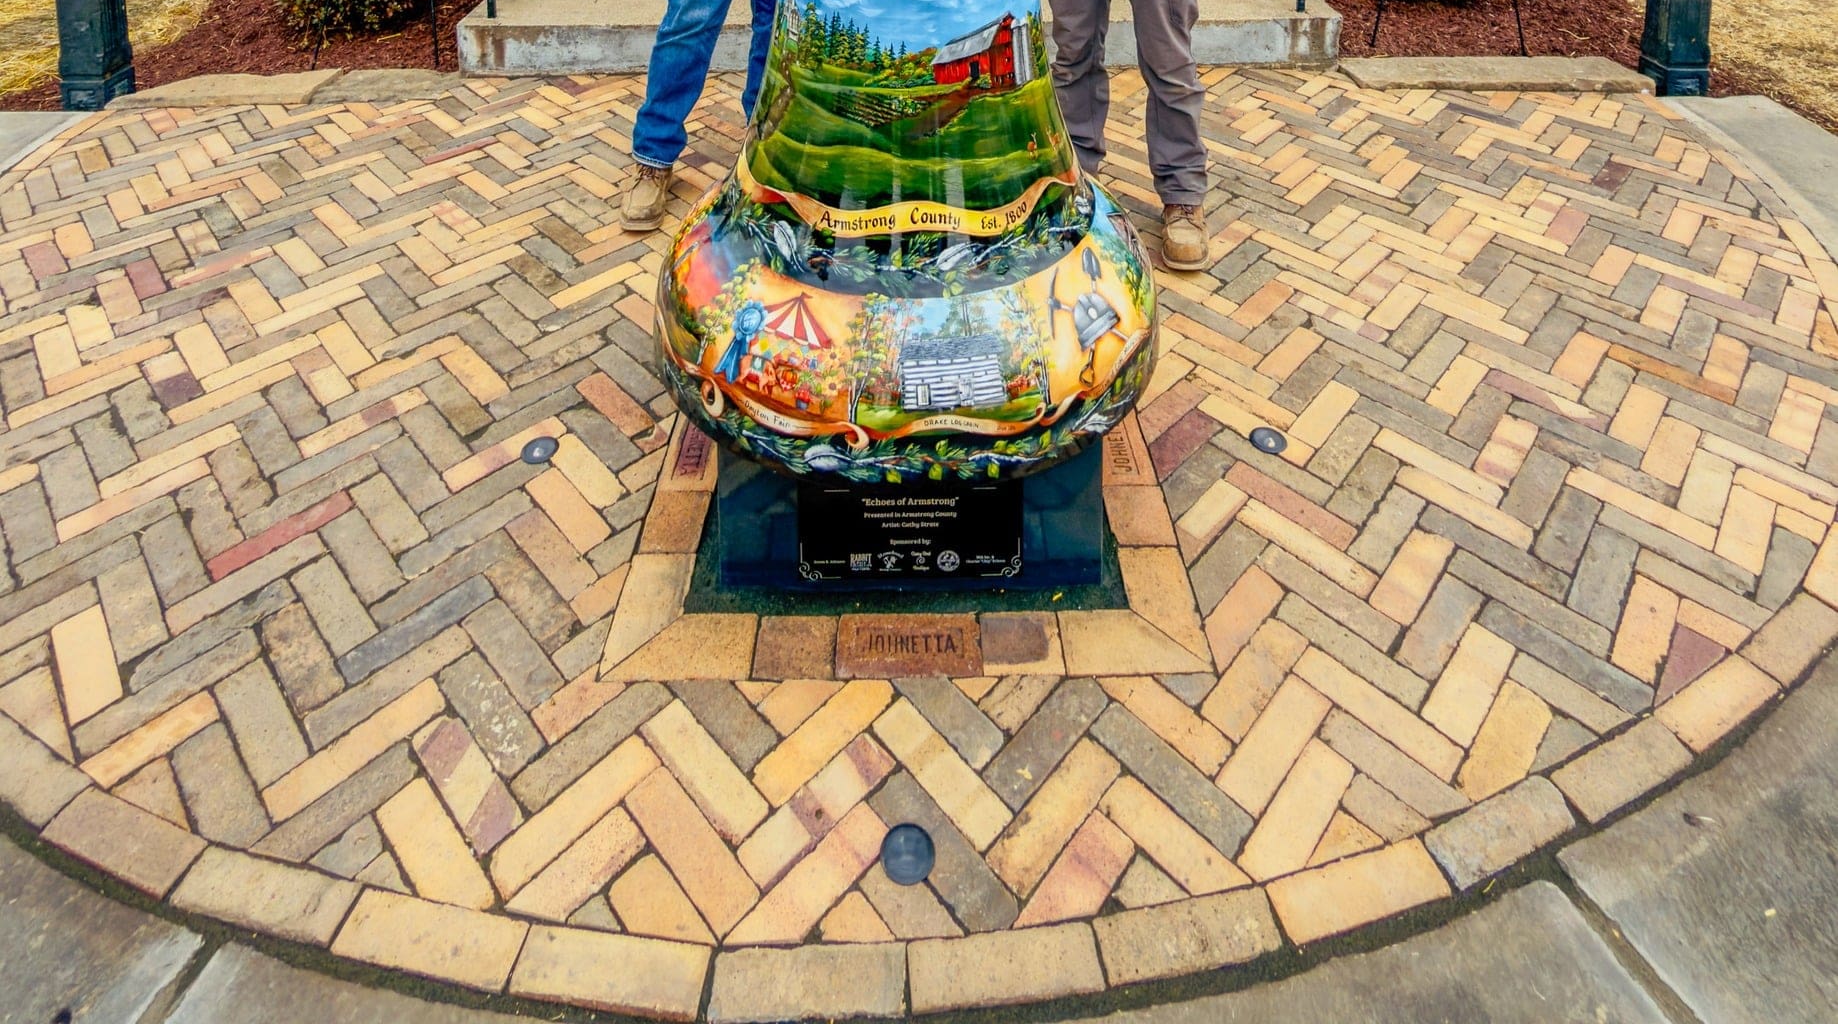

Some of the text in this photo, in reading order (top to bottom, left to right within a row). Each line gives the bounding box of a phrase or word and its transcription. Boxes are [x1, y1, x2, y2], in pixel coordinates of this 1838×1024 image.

[820, 201, 1028, 230] Armstrong County Est. 1800
[744, 400, 769, 421] Dayton
[924, 419, 947, 427] DRAKE
[896, 496, 907, 506] of
[901, 511, 935, 519] Armstrong
[935, 510, 958, 518] County
